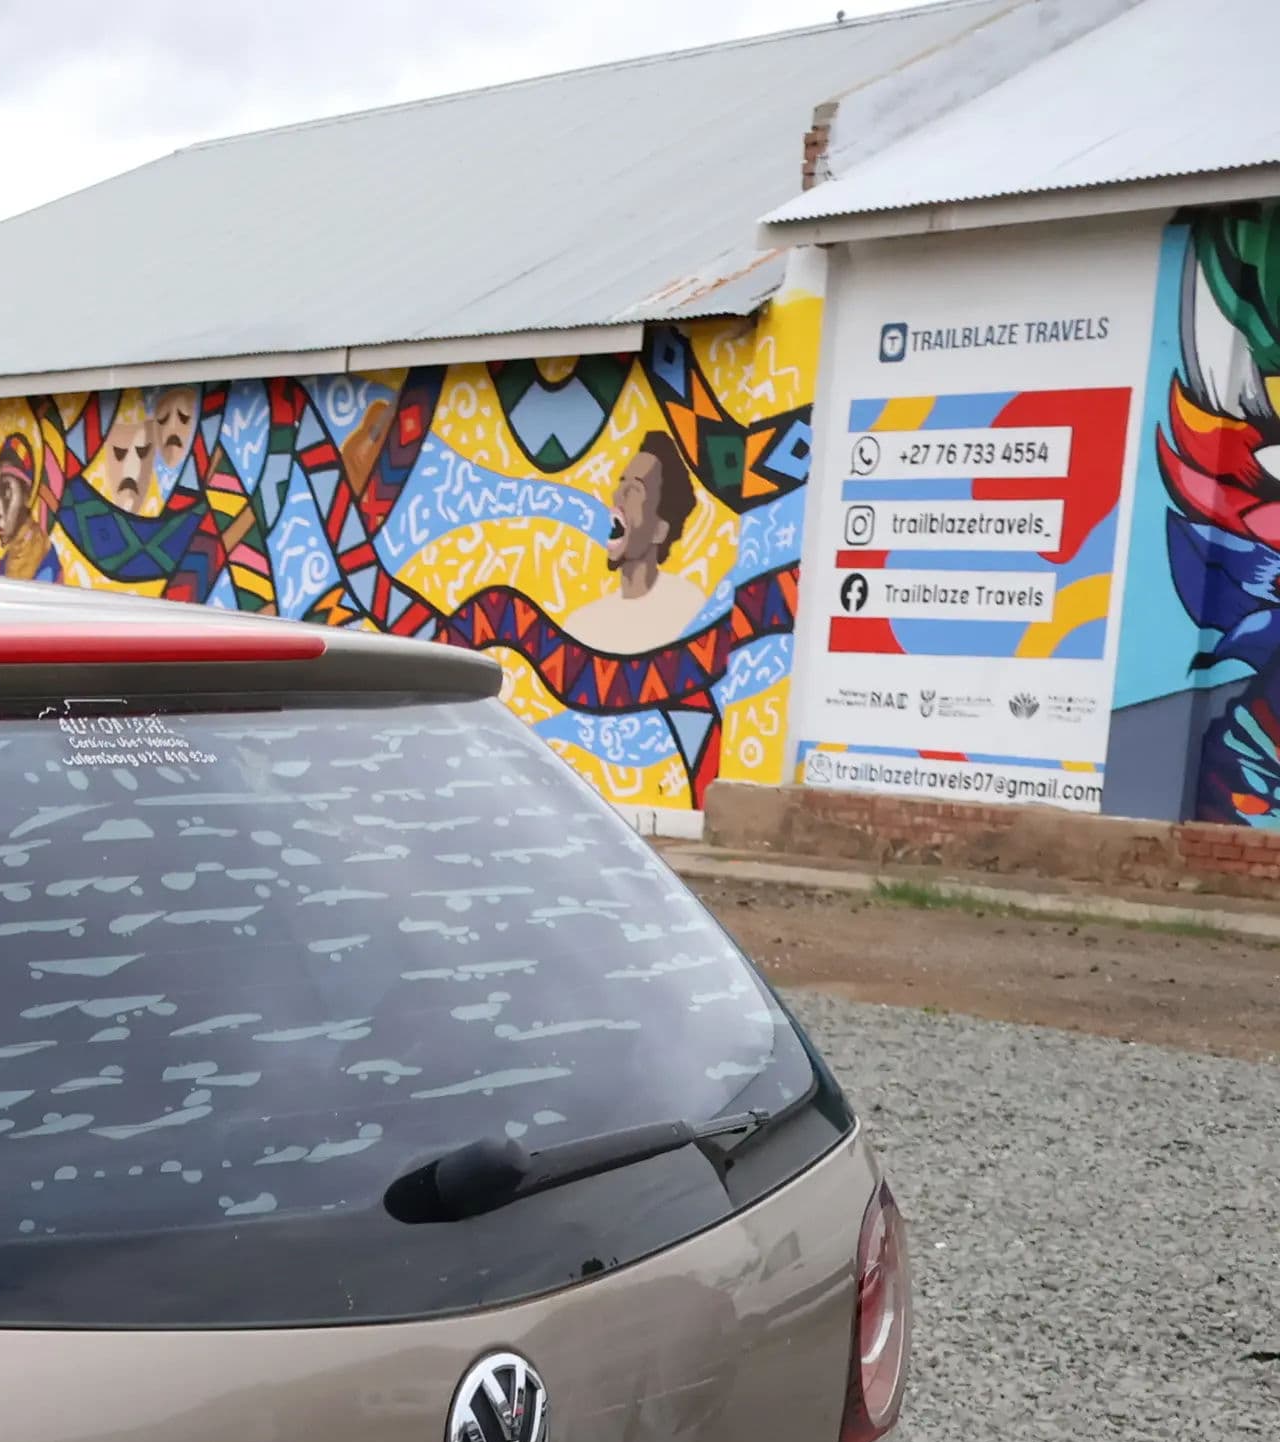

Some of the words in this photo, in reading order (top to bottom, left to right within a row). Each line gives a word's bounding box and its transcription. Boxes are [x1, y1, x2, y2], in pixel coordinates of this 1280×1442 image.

[911, 323, 1019, 352] TRAILBLAZE
[1024, 316, 1110, 344] TRAVELS
[900, 444, 930, 464] +27
[936, 444, 957, 464] 76
[963, 443, 995, 464] 733
[1001, 442, 1049, 464] 4554
[892, 512, 1051, 537] trailblazetravels_
[885, 584, 970, 604] Trailblaze
[976, 586, 1044, 607] Travels
[835, 762, 1103, 802] trailblazetravels07@gmail.com
